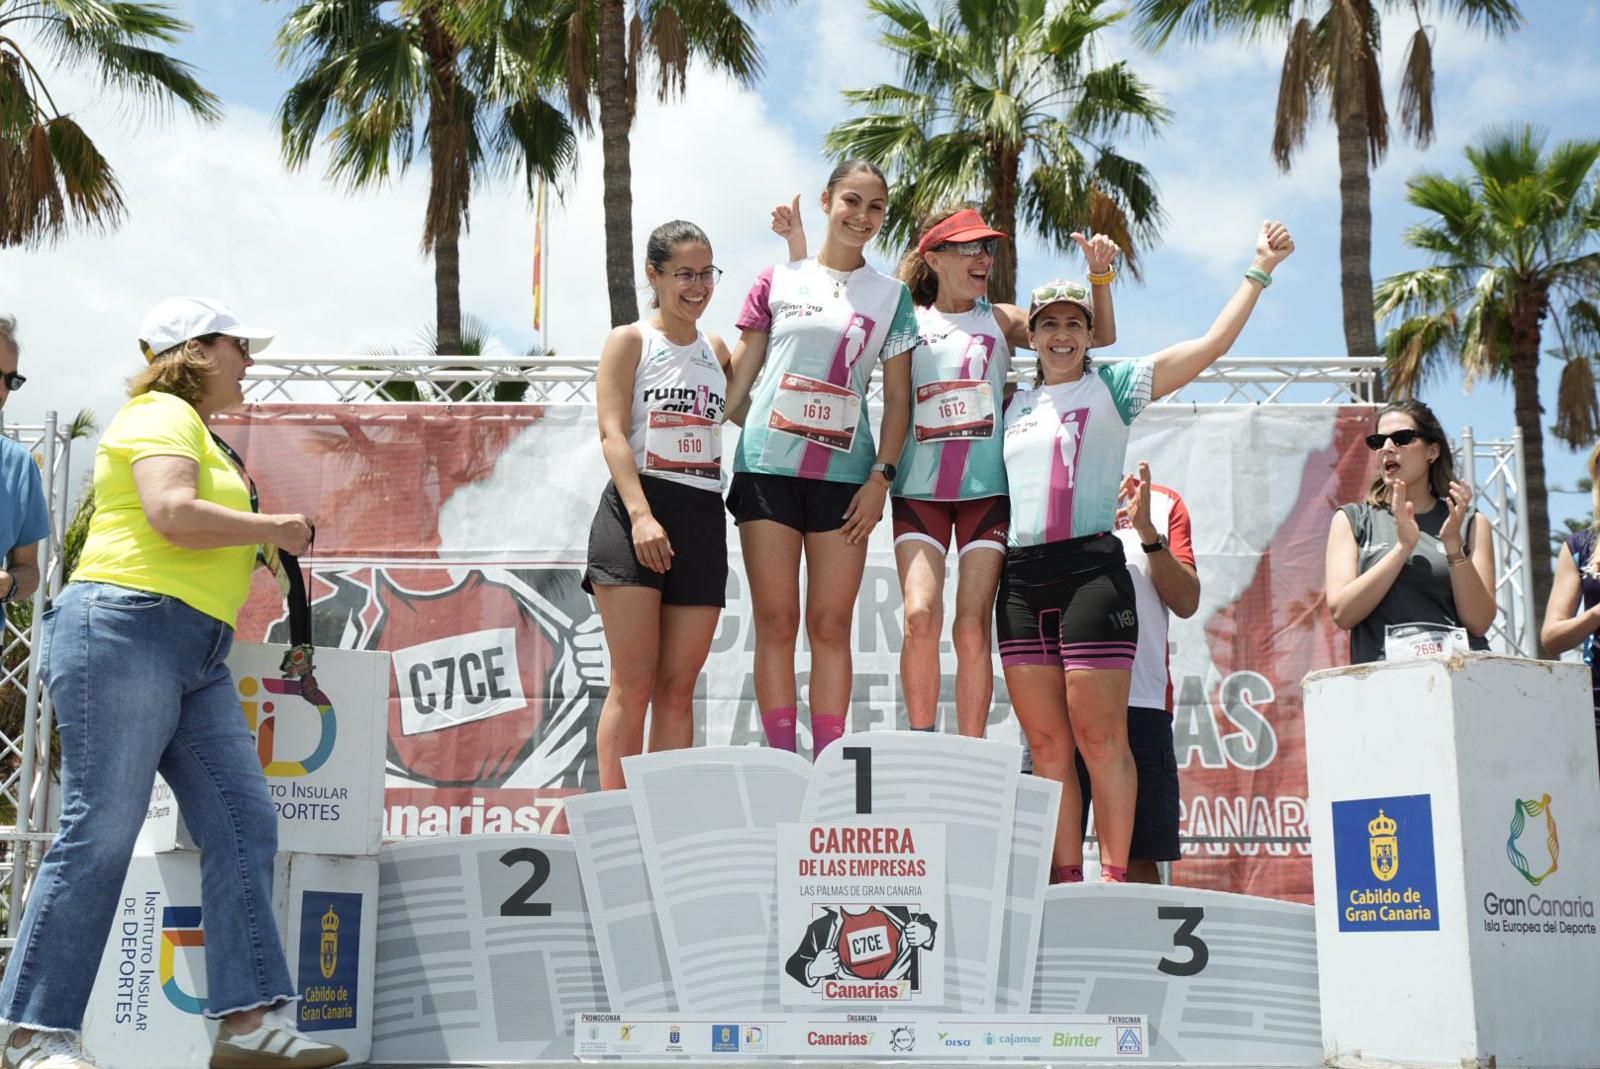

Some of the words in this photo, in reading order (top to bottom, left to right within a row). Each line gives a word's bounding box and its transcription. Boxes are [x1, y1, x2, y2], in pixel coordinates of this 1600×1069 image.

[803, 404, 831, 420] 1613
[938, 401, 967, 419] 1612
[678, 439, 702, 453] 1610
[1414, 643, 1443, 656] 2694
[409, 646, 511, 715] C7CE
[843, 747, 872, 814] 1
[292, 782, 348, 800] INSULAR
[809, 827, 915, 854] CARRERA
[799, 859, 817, 876] DE
[820, 859, 846, 876] LAS
[850, 859, 926, 877] EMPRESAS
[499, 847, 552, 917] 2
[800, 885, 816, 896] LAS
[816, 885, 849, 896] PALMAS
[850, 885, 861, 896] DE
[862, 885, 885, 897] GRAN
[886, 885, 922, 897] CANARIA
[1350, 888, 1400, 905] Cabildo
[1403, 887, 1421, 903] de
[1483, 891, 1527, 916] Gran
[1527, 893, 1594, 918] Canaria
[124, 897, 136, 916] DE
[1345, 906, 1377, 922] Gran
[1379, 904, 1431, 920] Canaria
[140, 891, 161, 964] INSTITUTO
[1484, 919, 1500, 932] Isla
[1502, 920, 1541, 935] Europea
[1543, 921, 1557, 933] del
[1559, 921, 1597, 936] Deporte
[851, 934, 883, 955] C7CE
[1157, 906, 1209, 976] 3
[115, 921, 138, 1024] DEPORTES
[135, 969, 155, 1031] INSULAR
[305, 985, 336, 1002] Cabildo
[337, 984, 348, 1000] de
[301, 1005, 321, 1021] Gran
[322, 1003, 353, 1019] Canaria
[847, 1014, 877, 1022] ORGANIZAN
[1108, 1016, 1141, 1024] PATROCINAN
[999, 1033, 1041, 1045] cajamar
[1052, 1032, 1102, 1047] Binter
